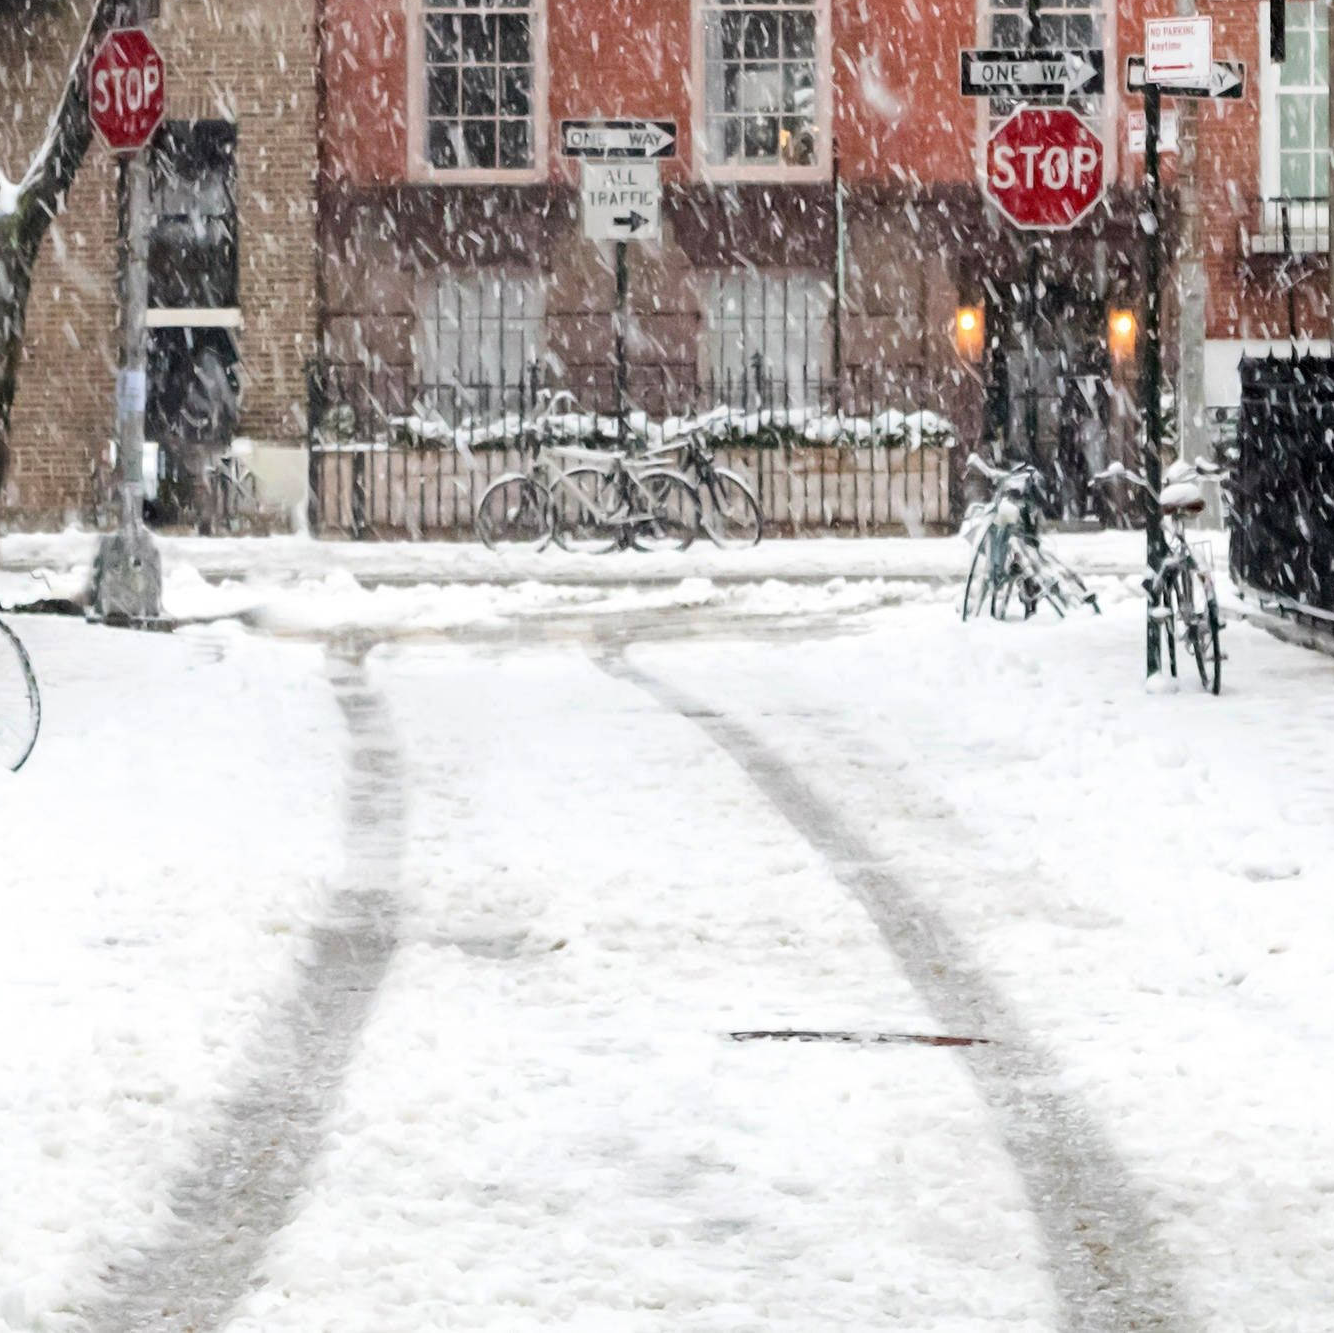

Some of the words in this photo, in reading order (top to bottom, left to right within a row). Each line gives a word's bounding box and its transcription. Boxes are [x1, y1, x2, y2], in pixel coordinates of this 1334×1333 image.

[982, 64, 1022, 83] ONE
[1042, 64, 1082, 82] WAY
[93, 66, 160, 117] STOP
[628, 131, 662, 146] WAY
[992, 145, 1099, 191] STOP
[603, 169, 638, 187] ALL
[588, 191, 653, 206] TRAFFIC
